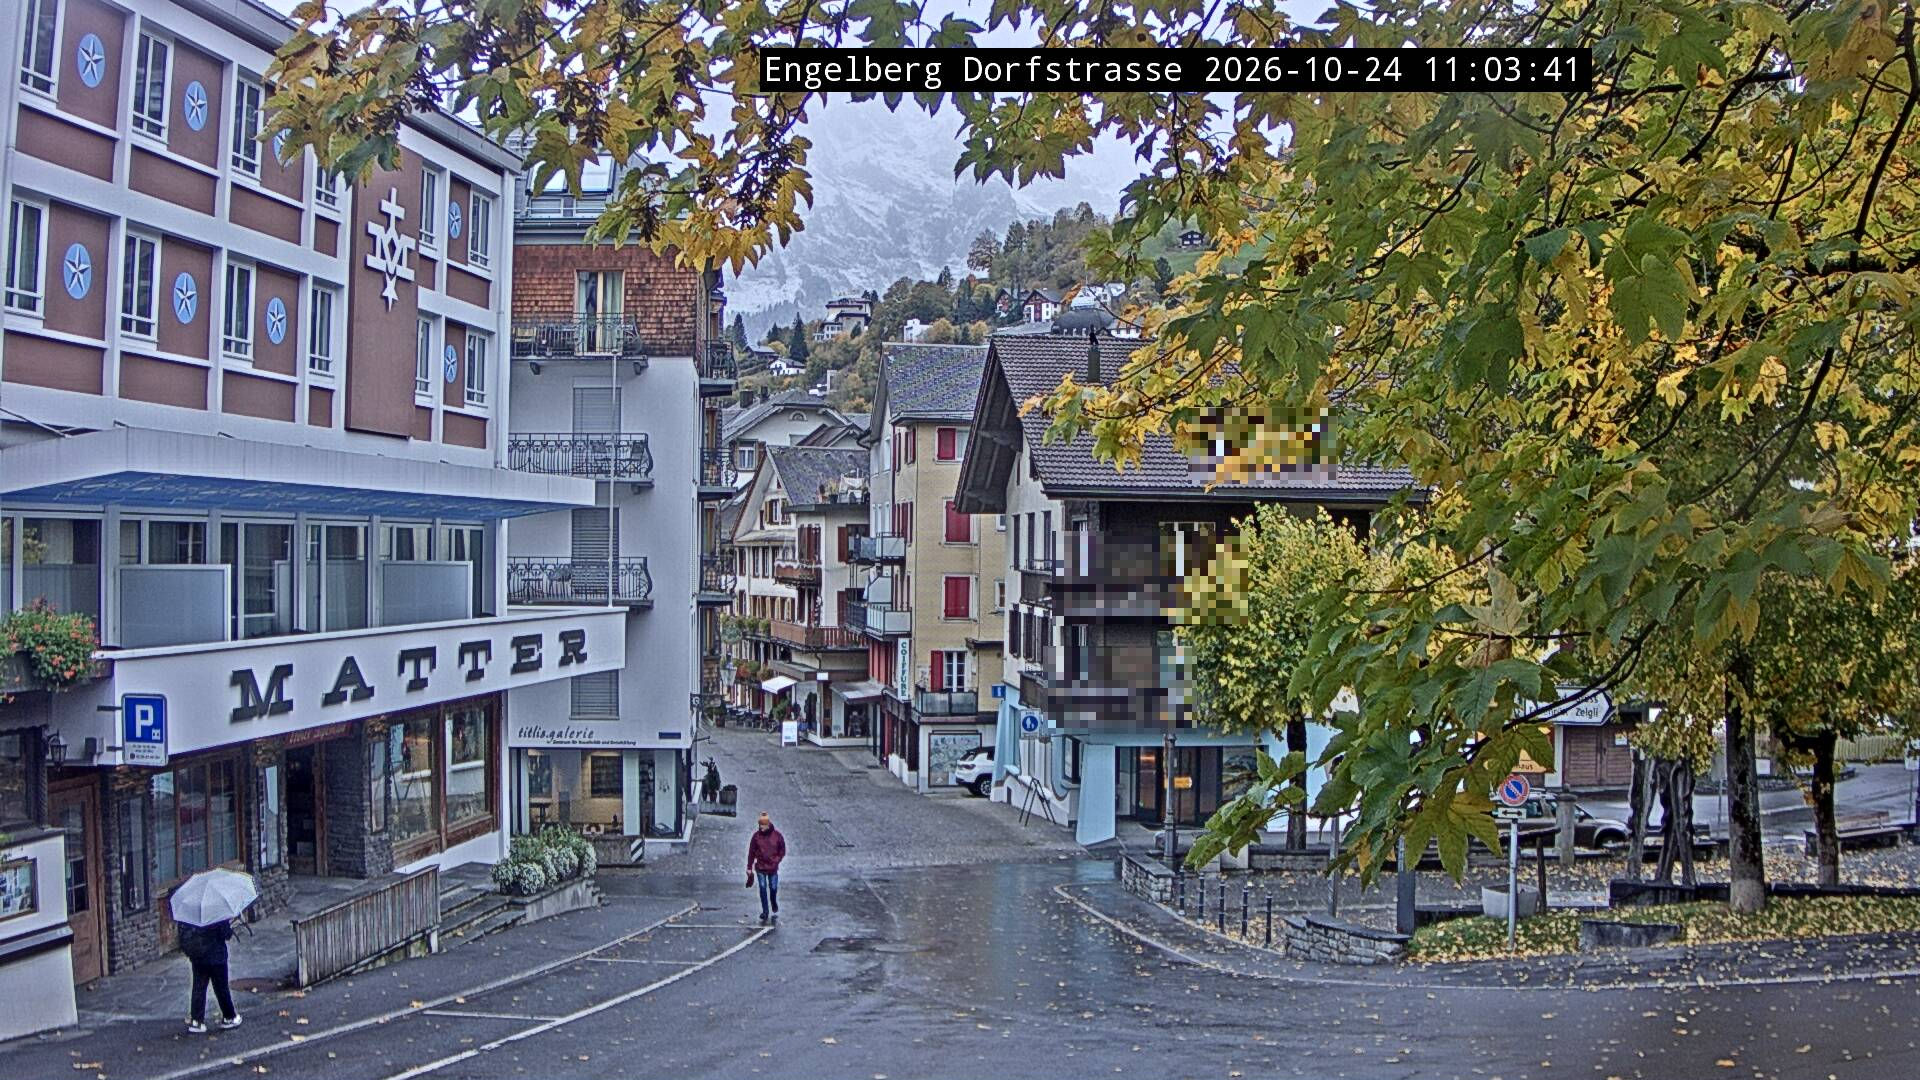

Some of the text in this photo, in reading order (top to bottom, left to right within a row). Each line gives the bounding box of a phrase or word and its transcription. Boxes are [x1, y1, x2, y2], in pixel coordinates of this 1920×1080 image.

[229, 628, 588, 723] MATTER
[135, 704, 154, 738] P
[1575, 707, 1599, 719] Zelgli
